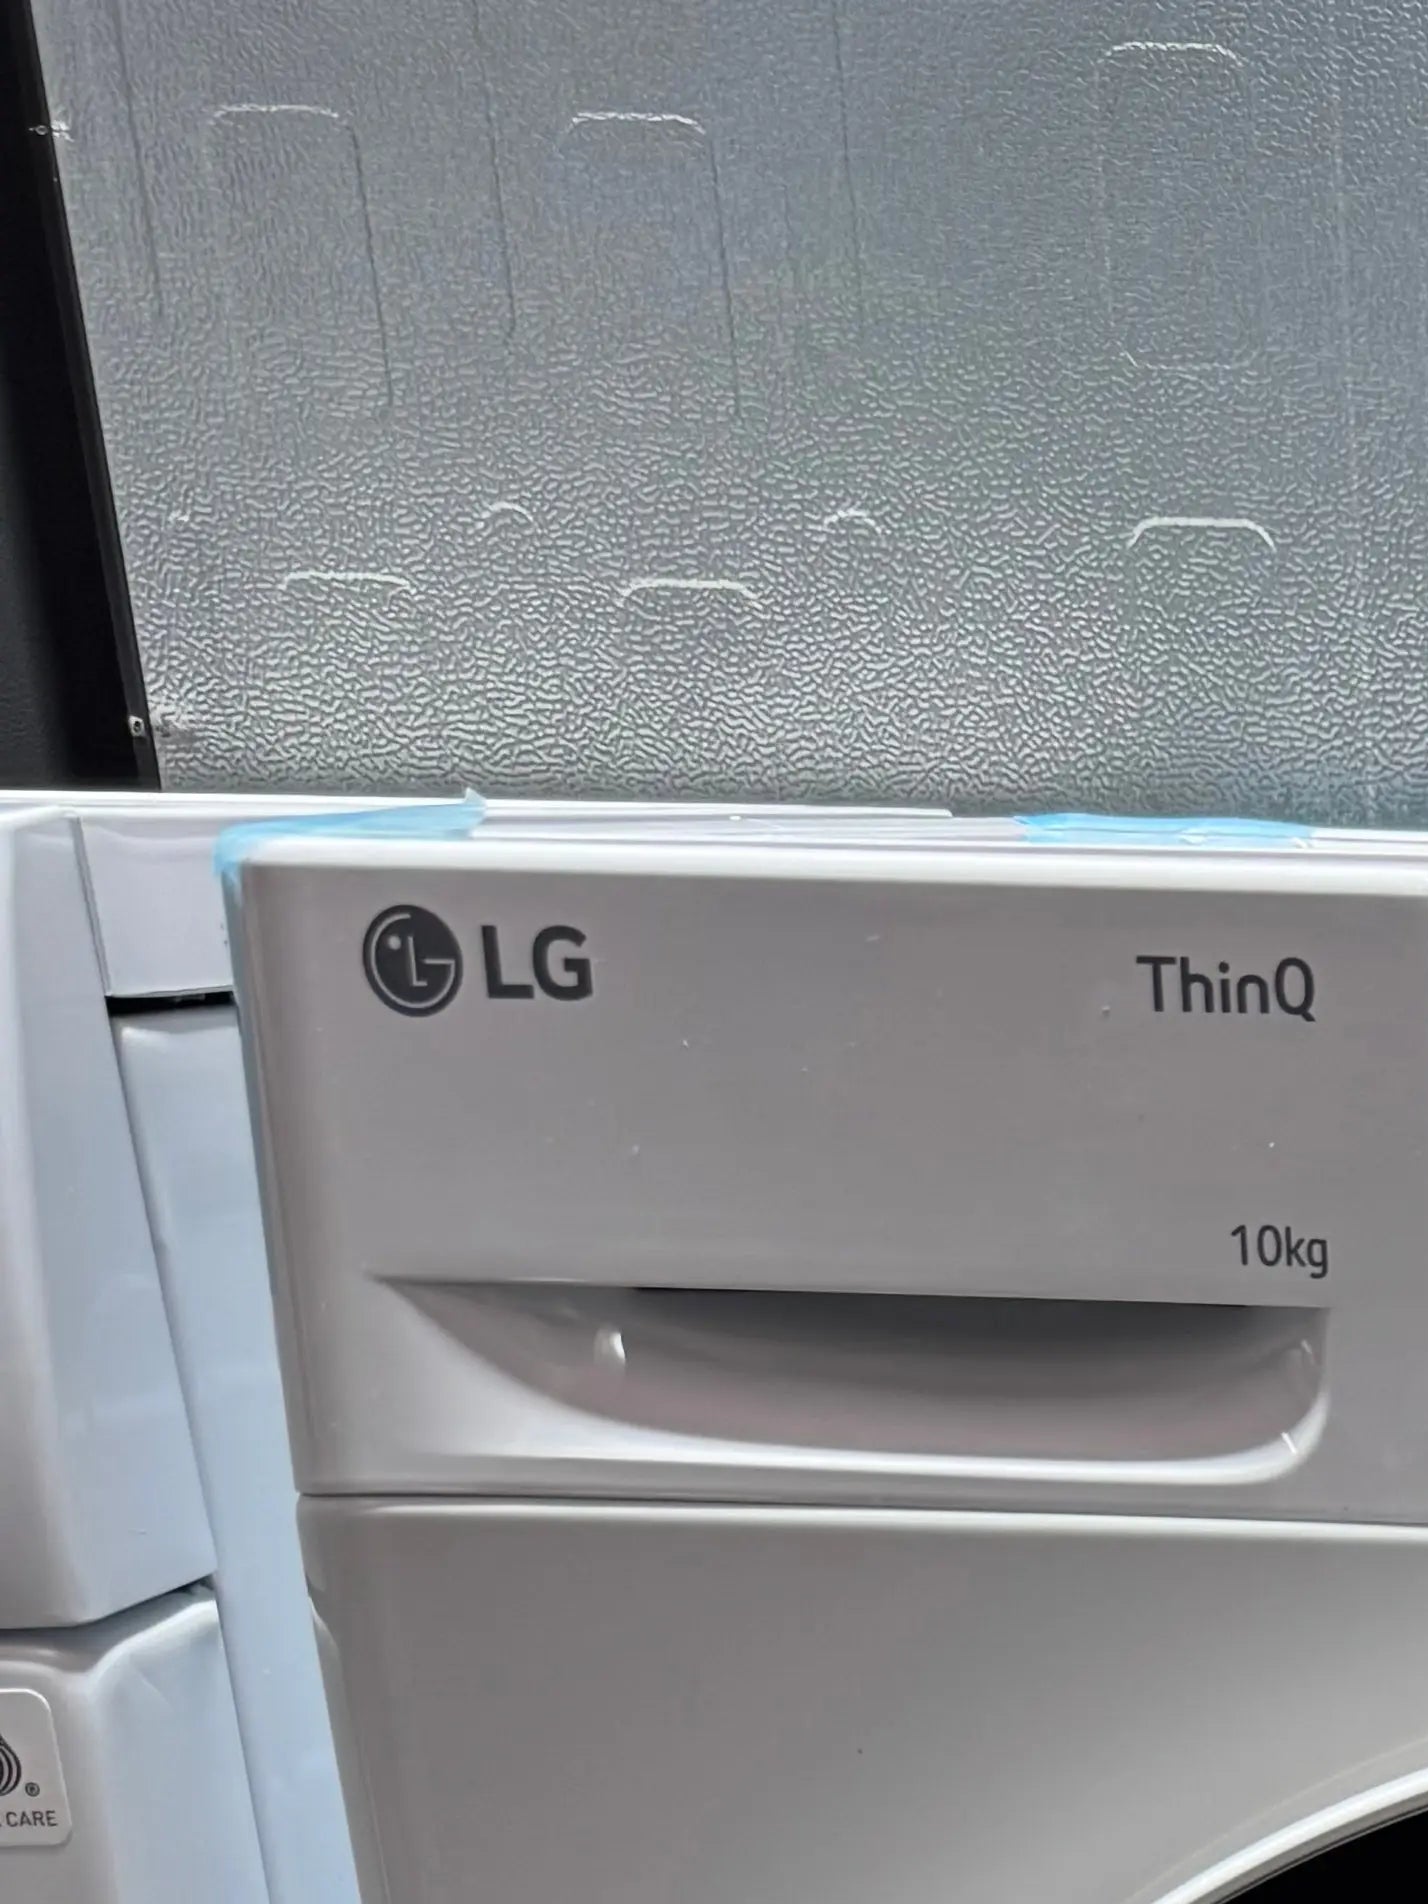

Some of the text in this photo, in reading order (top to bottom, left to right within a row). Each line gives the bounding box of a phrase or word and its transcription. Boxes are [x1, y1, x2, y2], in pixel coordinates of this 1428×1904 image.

[483, 924, 594, 1000] LG
[1135, 955, 1317, 1023] ThinQ
[1230, 1222, 1330, 1279] 10kg
[5, 1810, 59, 1828] CARE
